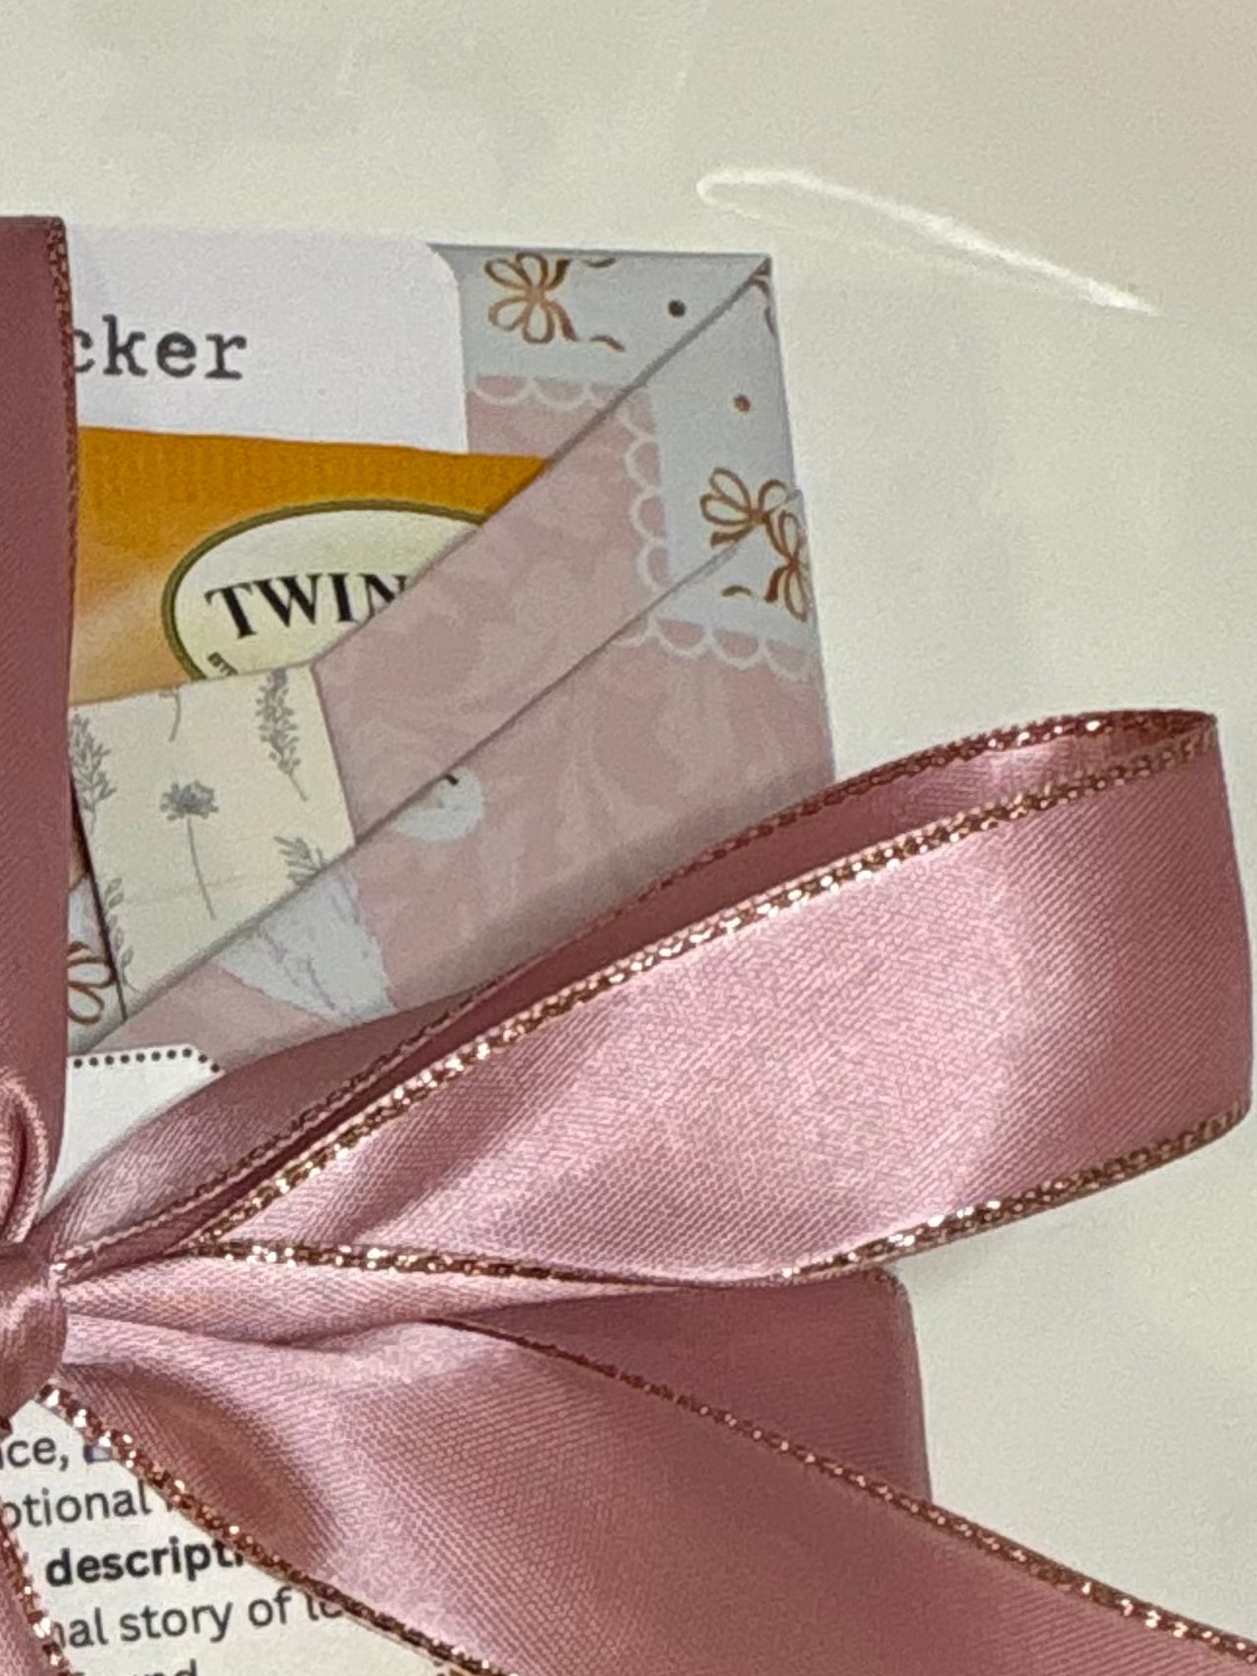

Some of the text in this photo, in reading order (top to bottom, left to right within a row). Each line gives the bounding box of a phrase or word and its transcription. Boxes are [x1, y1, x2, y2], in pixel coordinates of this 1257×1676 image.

[204, 572, 409, 639] TWIN
[119, 1602, 233, 1643] story
[248, 1586, 292, 1627] of
